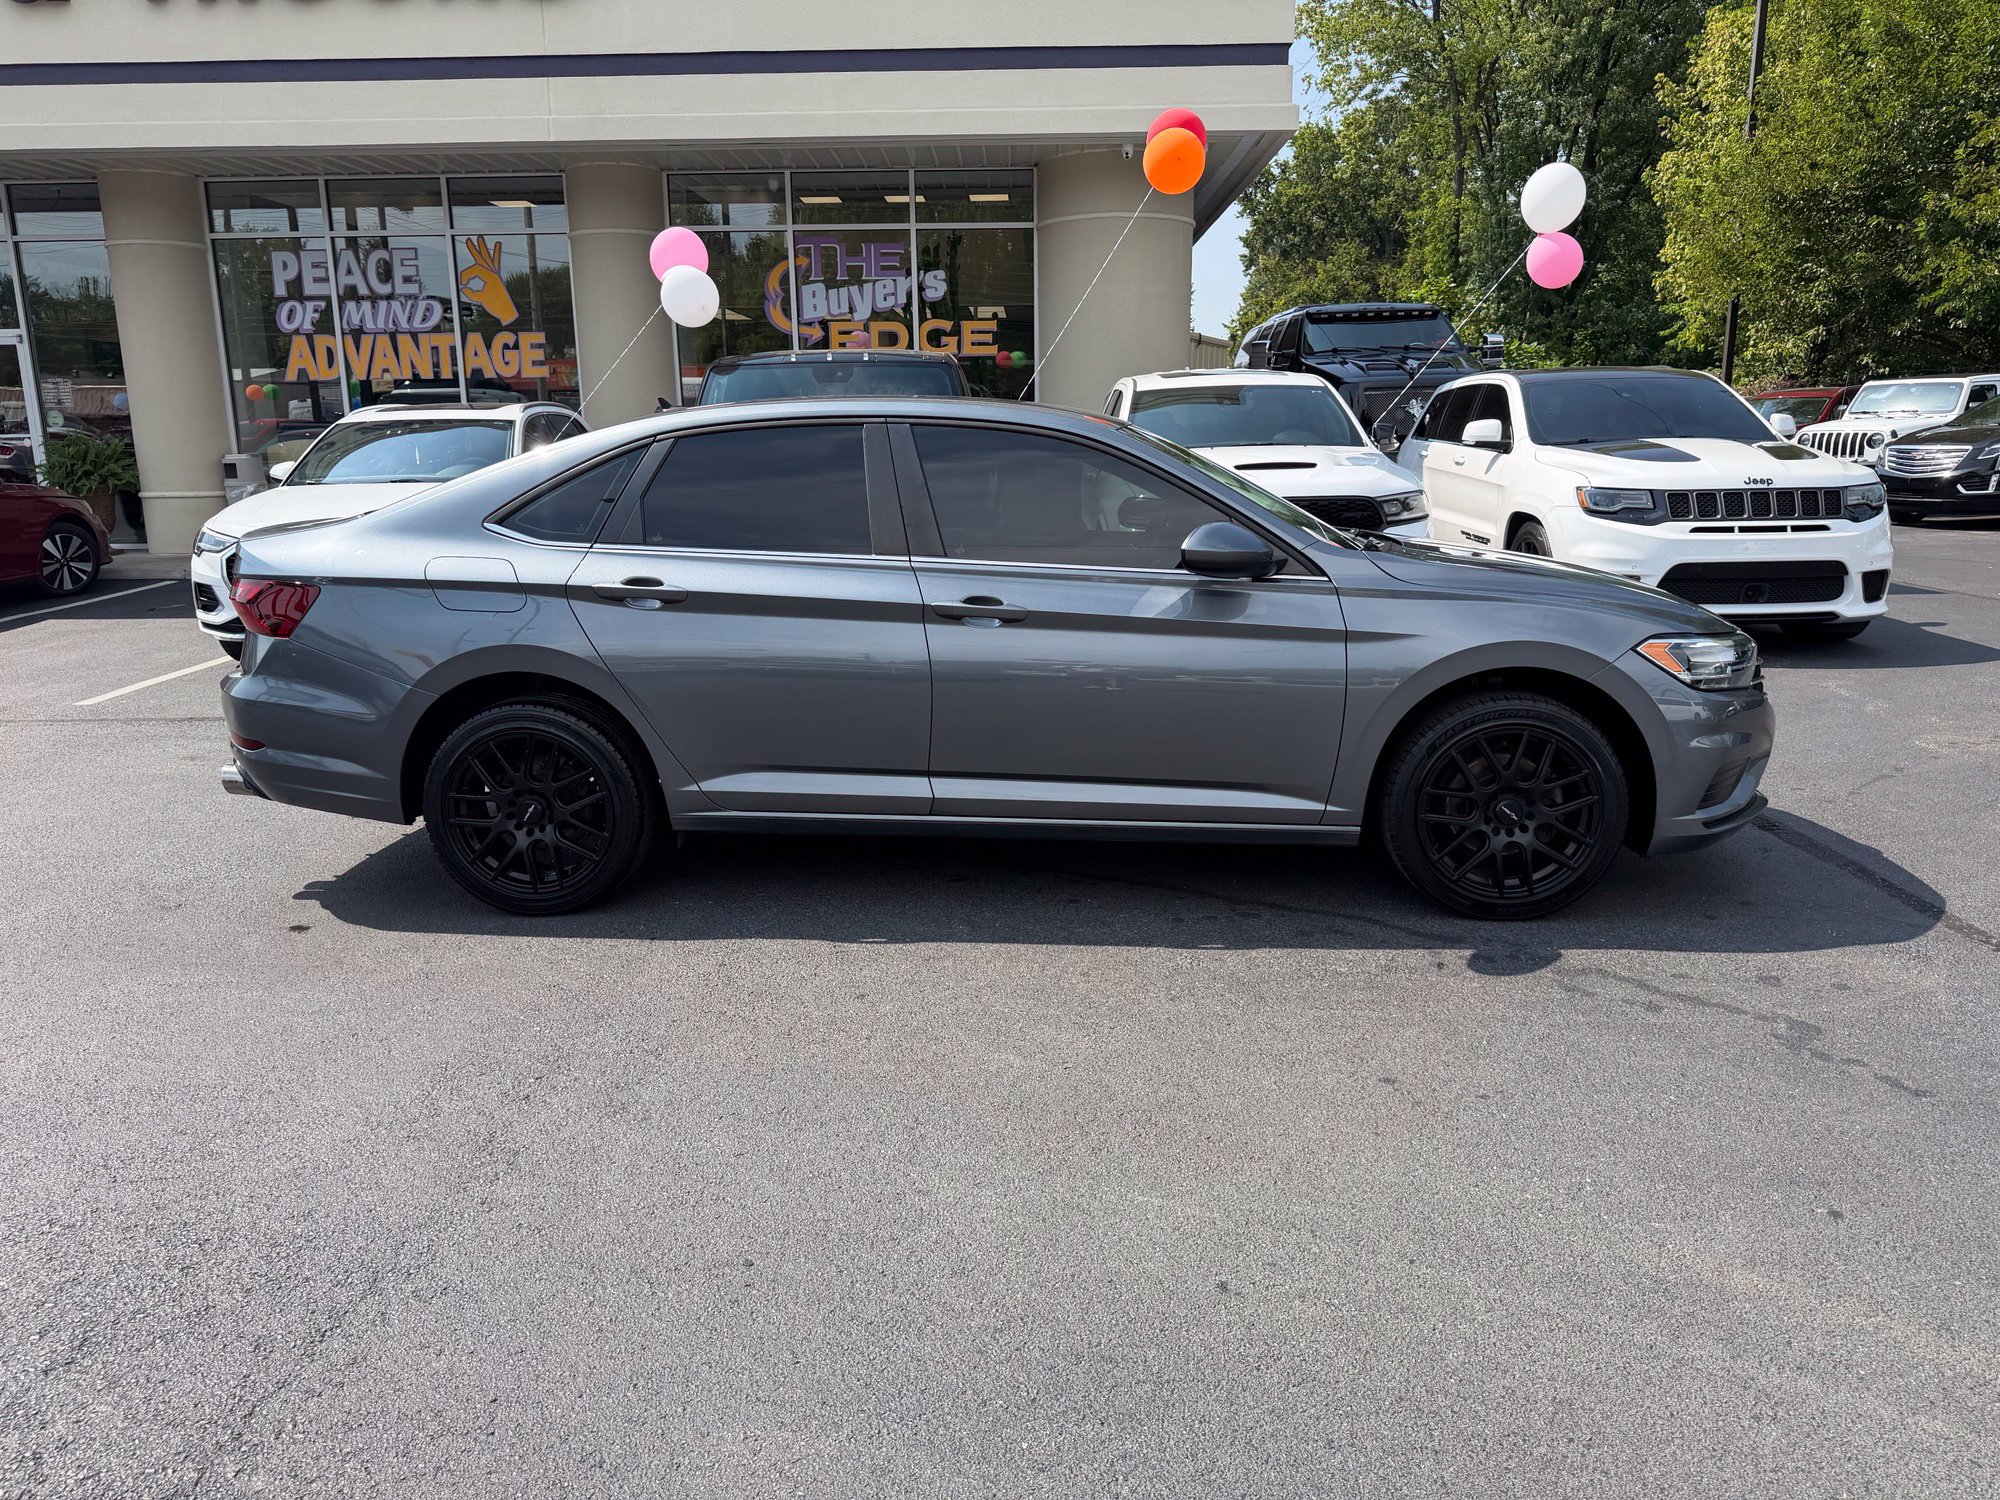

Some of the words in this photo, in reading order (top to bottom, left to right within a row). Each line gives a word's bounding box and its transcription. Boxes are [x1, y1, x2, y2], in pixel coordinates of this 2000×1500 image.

[271, 246, 423, 298] PEACE
[793, 235, 907, 281] THE
[275, 300, 327, 334] OF
[340, 299, 444, 334] MIND
[827, 318, 999, 357] EDGE
[284, 331, 550, 382] ADVANTAGE
[1744, 476, 1774, 487] Jeep
